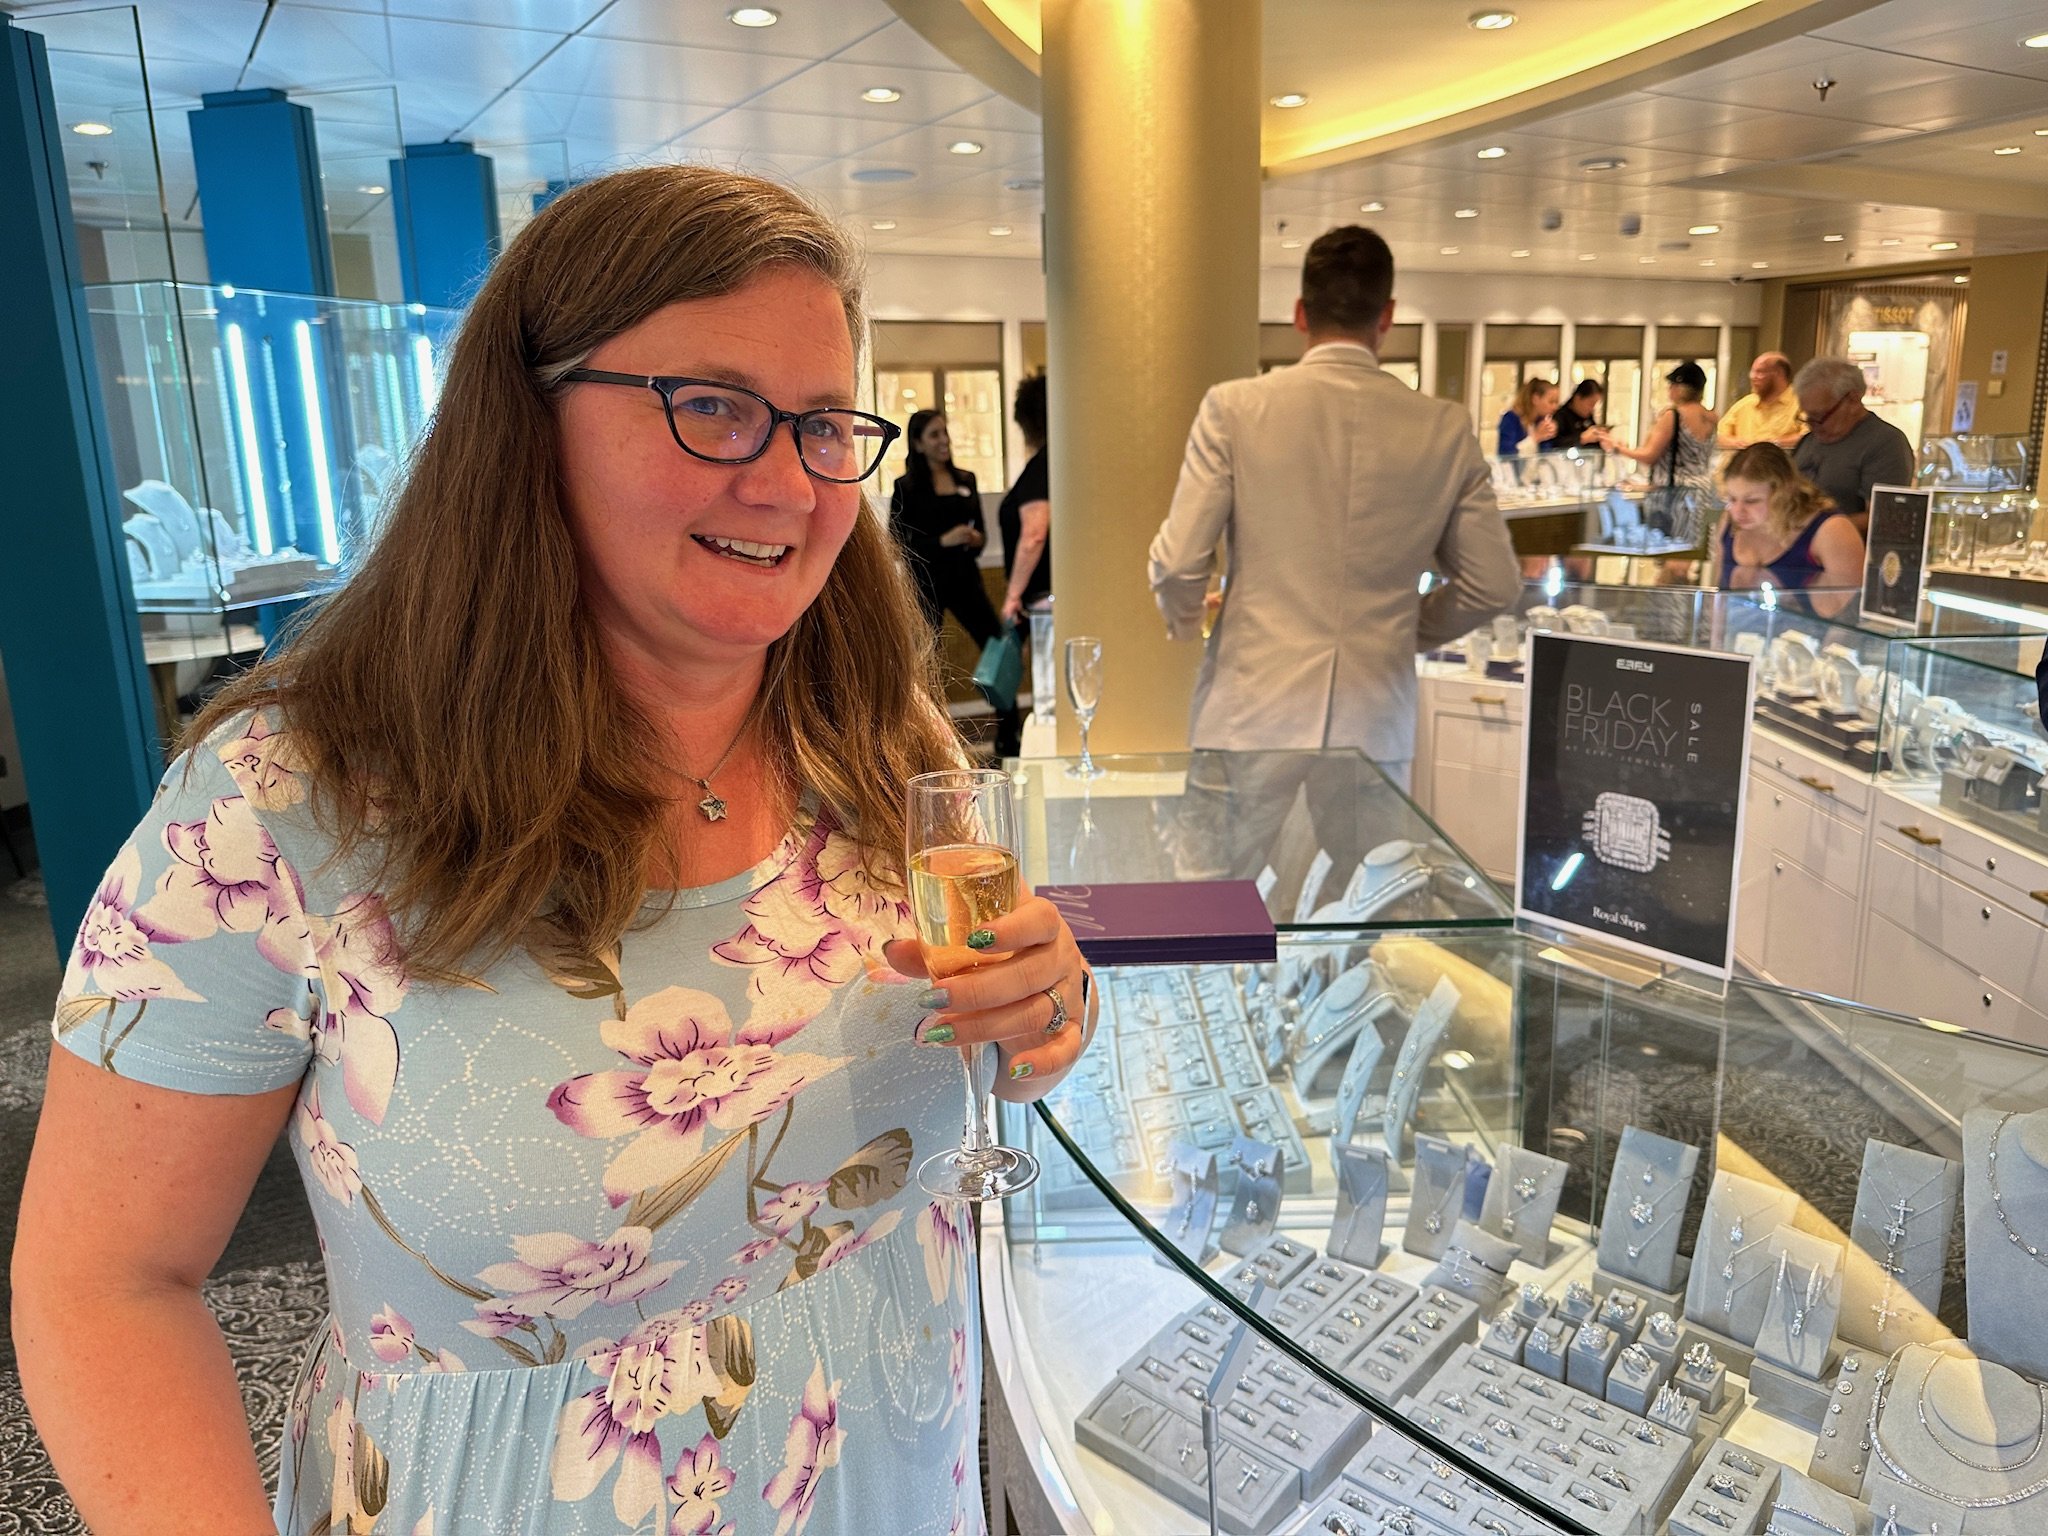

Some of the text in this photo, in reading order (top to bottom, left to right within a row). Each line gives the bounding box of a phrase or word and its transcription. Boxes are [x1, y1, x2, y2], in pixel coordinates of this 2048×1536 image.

[1566, 683, 1672, 728] BLACK
[1564, 712, 1679, 757] FRIDAY
[1686, 702, 1702, 763] SALE
[1592, 905, 1648, 933] Royal Shops
